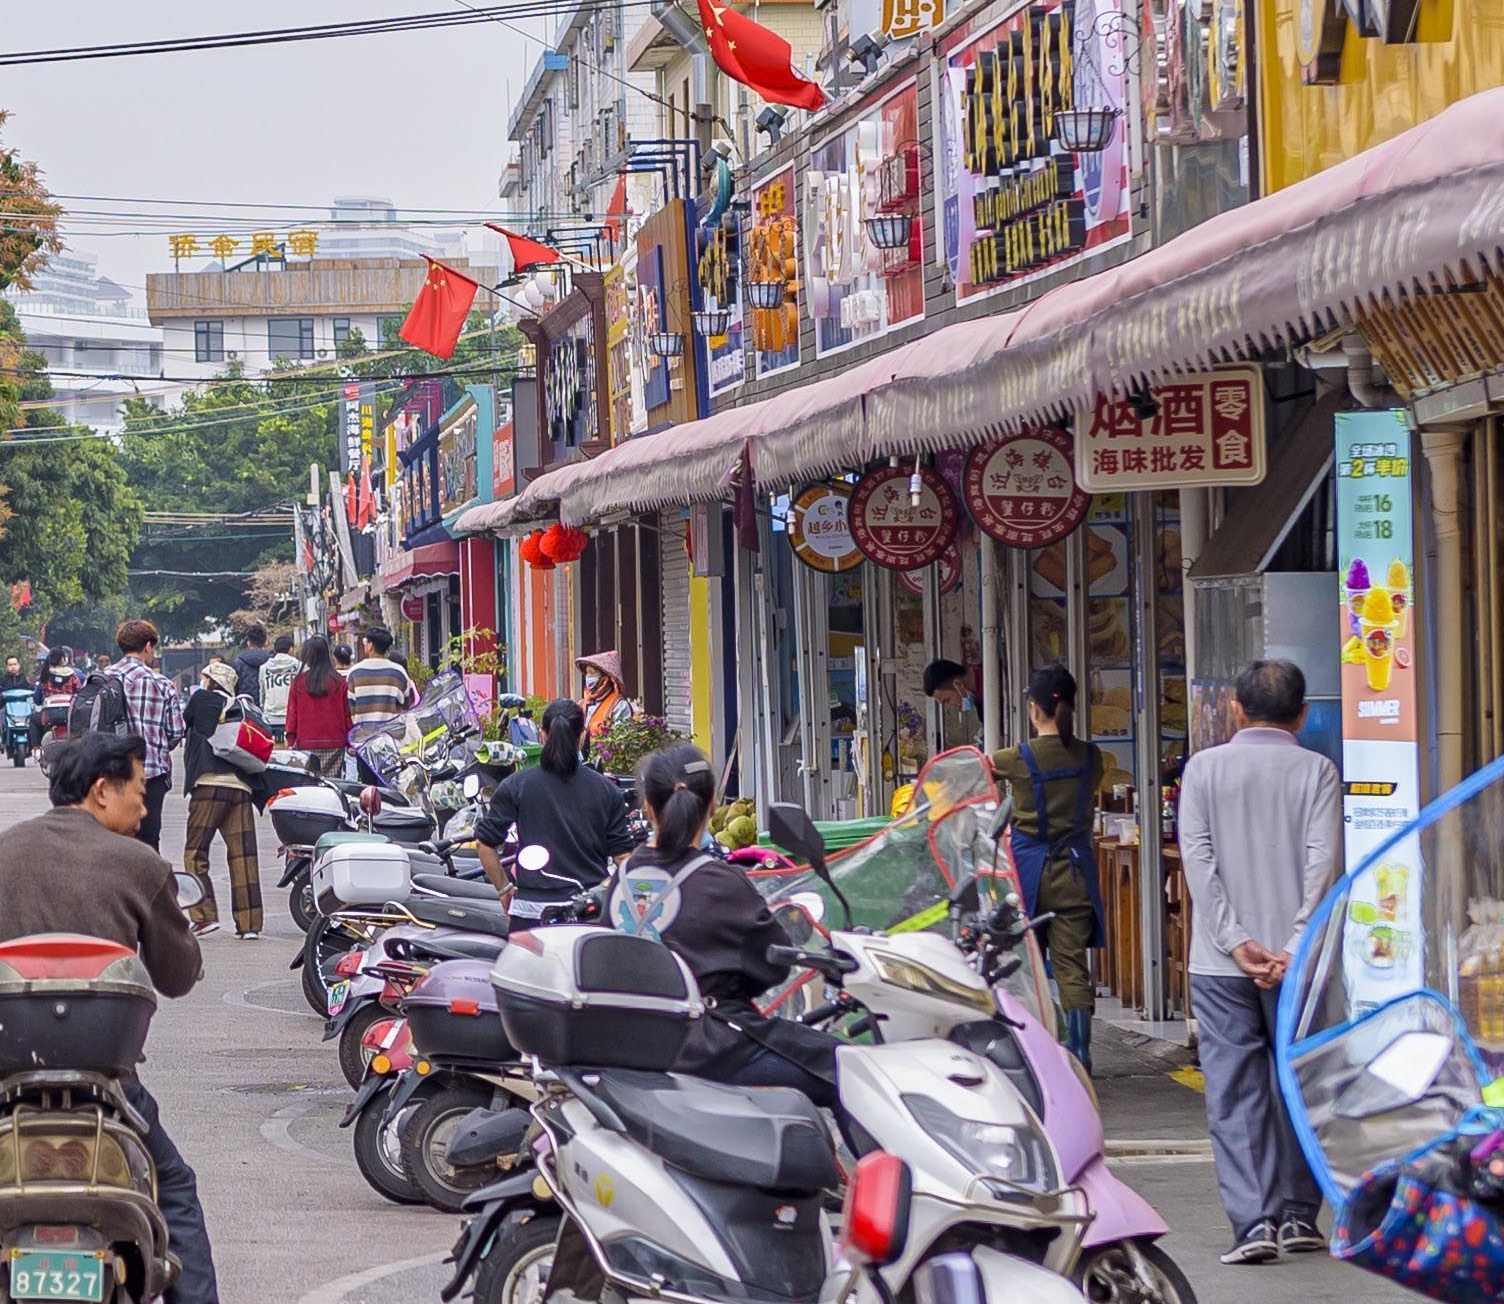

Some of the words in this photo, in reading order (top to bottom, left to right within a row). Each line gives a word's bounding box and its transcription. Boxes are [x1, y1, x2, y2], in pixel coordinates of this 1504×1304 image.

[1090, 383, 1205, 440] 烟酒
[1215, 386, 1249, 467] 零食
[1093, 444, 1206, 475] 海味批发
[1000, 499, 1056, 519] 蟹仔粉
[1374, 494, 1392, 513] 16
[880, 526, 928, 546] 蟹仔粉
[1374, 520, 1392, 539] 18
[1358, 700, 1400, 717] SUMMER
[16, 1271, 97, 1297] 87327
